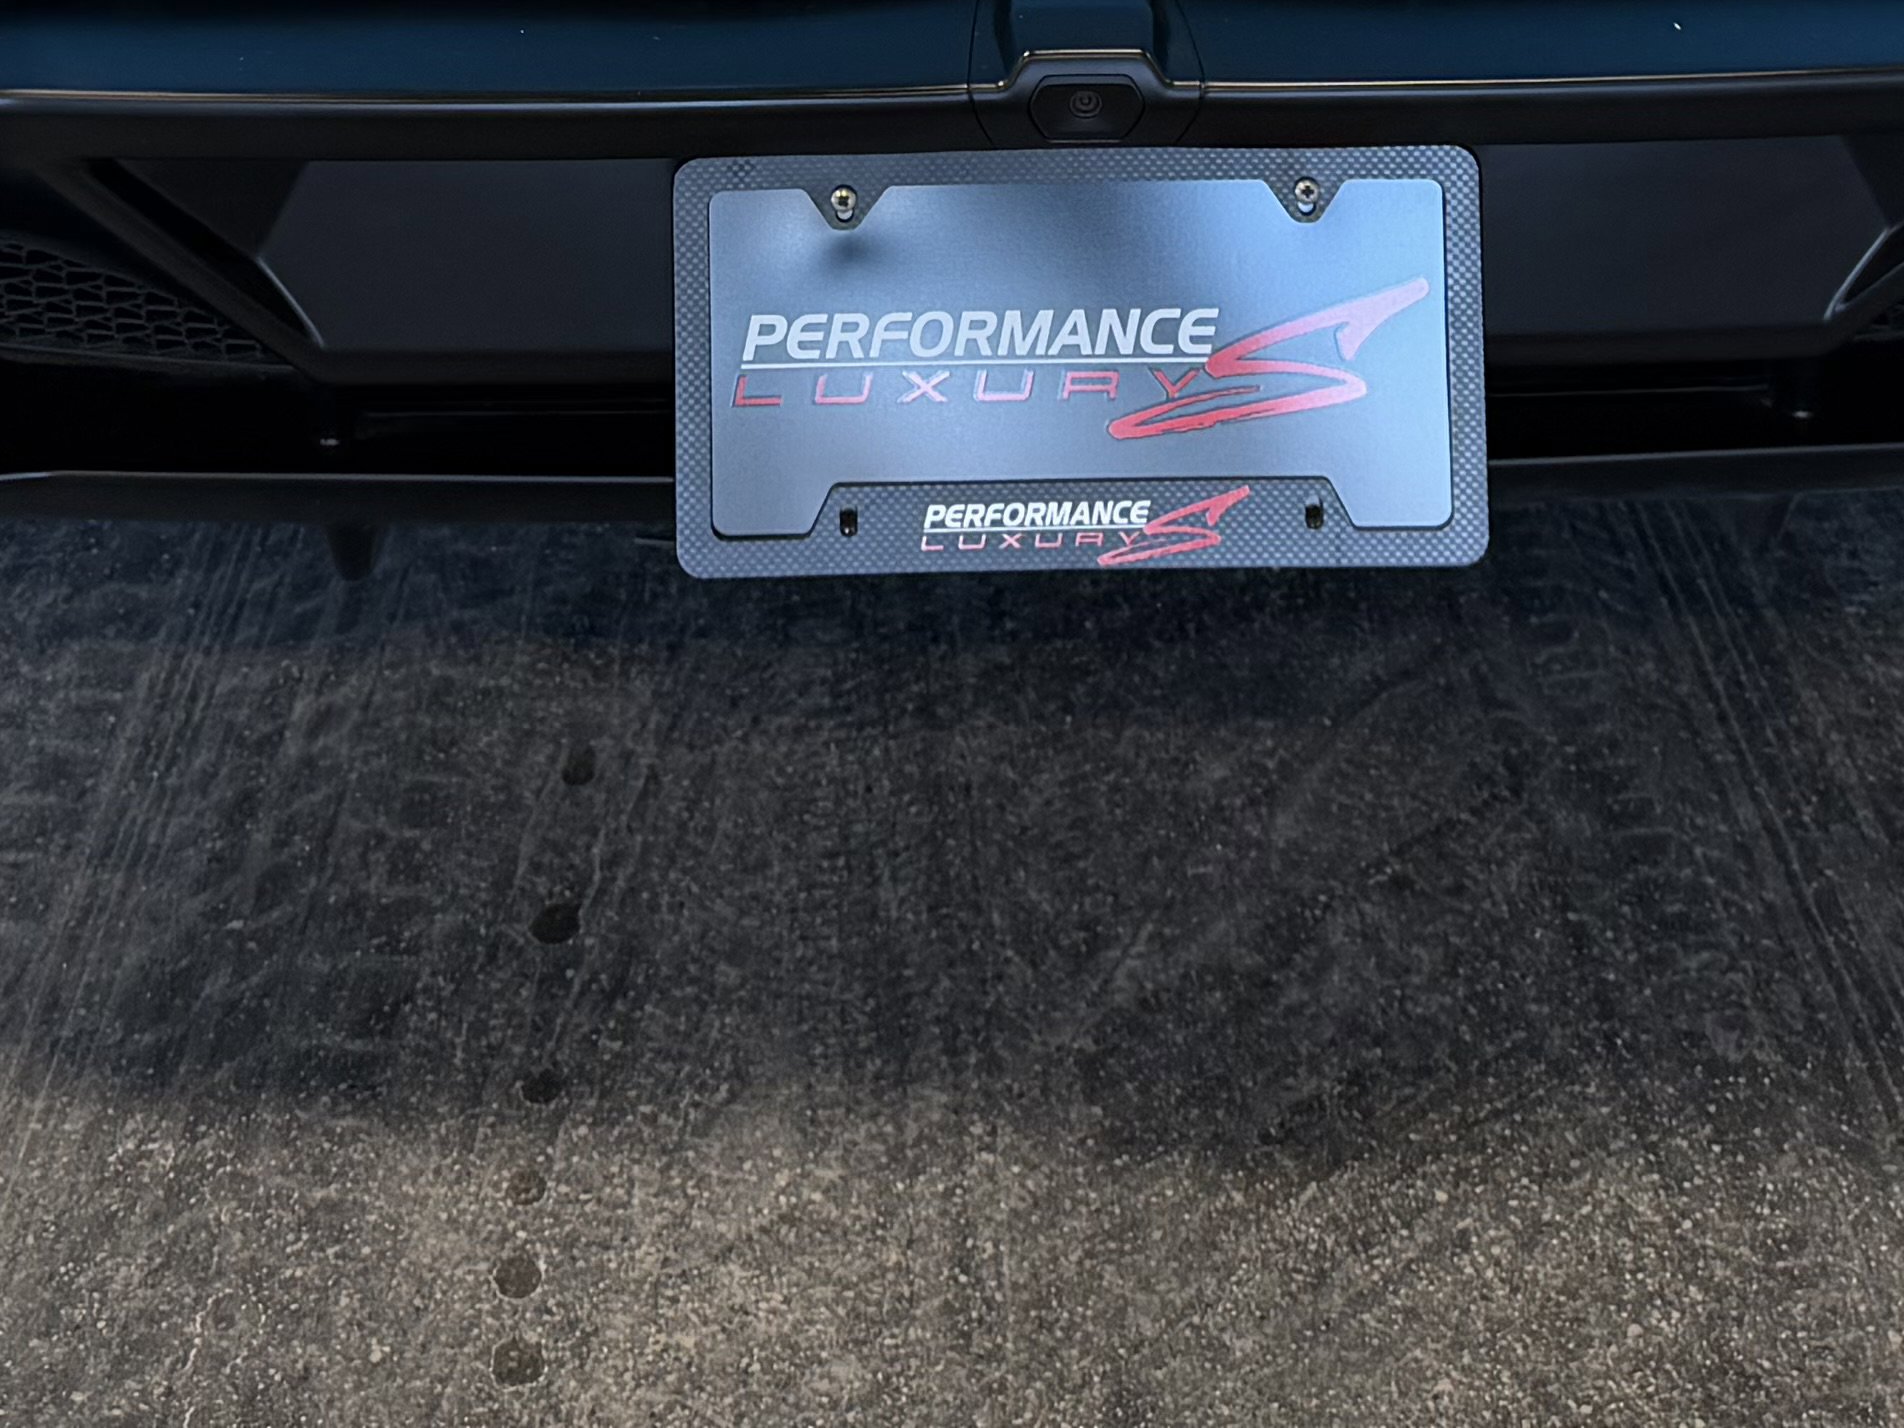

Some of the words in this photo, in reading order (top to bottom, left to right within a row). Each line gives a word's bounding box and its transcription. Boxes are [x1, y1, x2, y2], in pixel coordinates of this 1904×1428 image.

[743, 308, 1220, 361] PERFORMANCE
[730, 368, 1200, 408] LUXURY
[924, 500, 1151, 529] PERFORMANCE
[921, 531, 1141, 551] LUXURY
